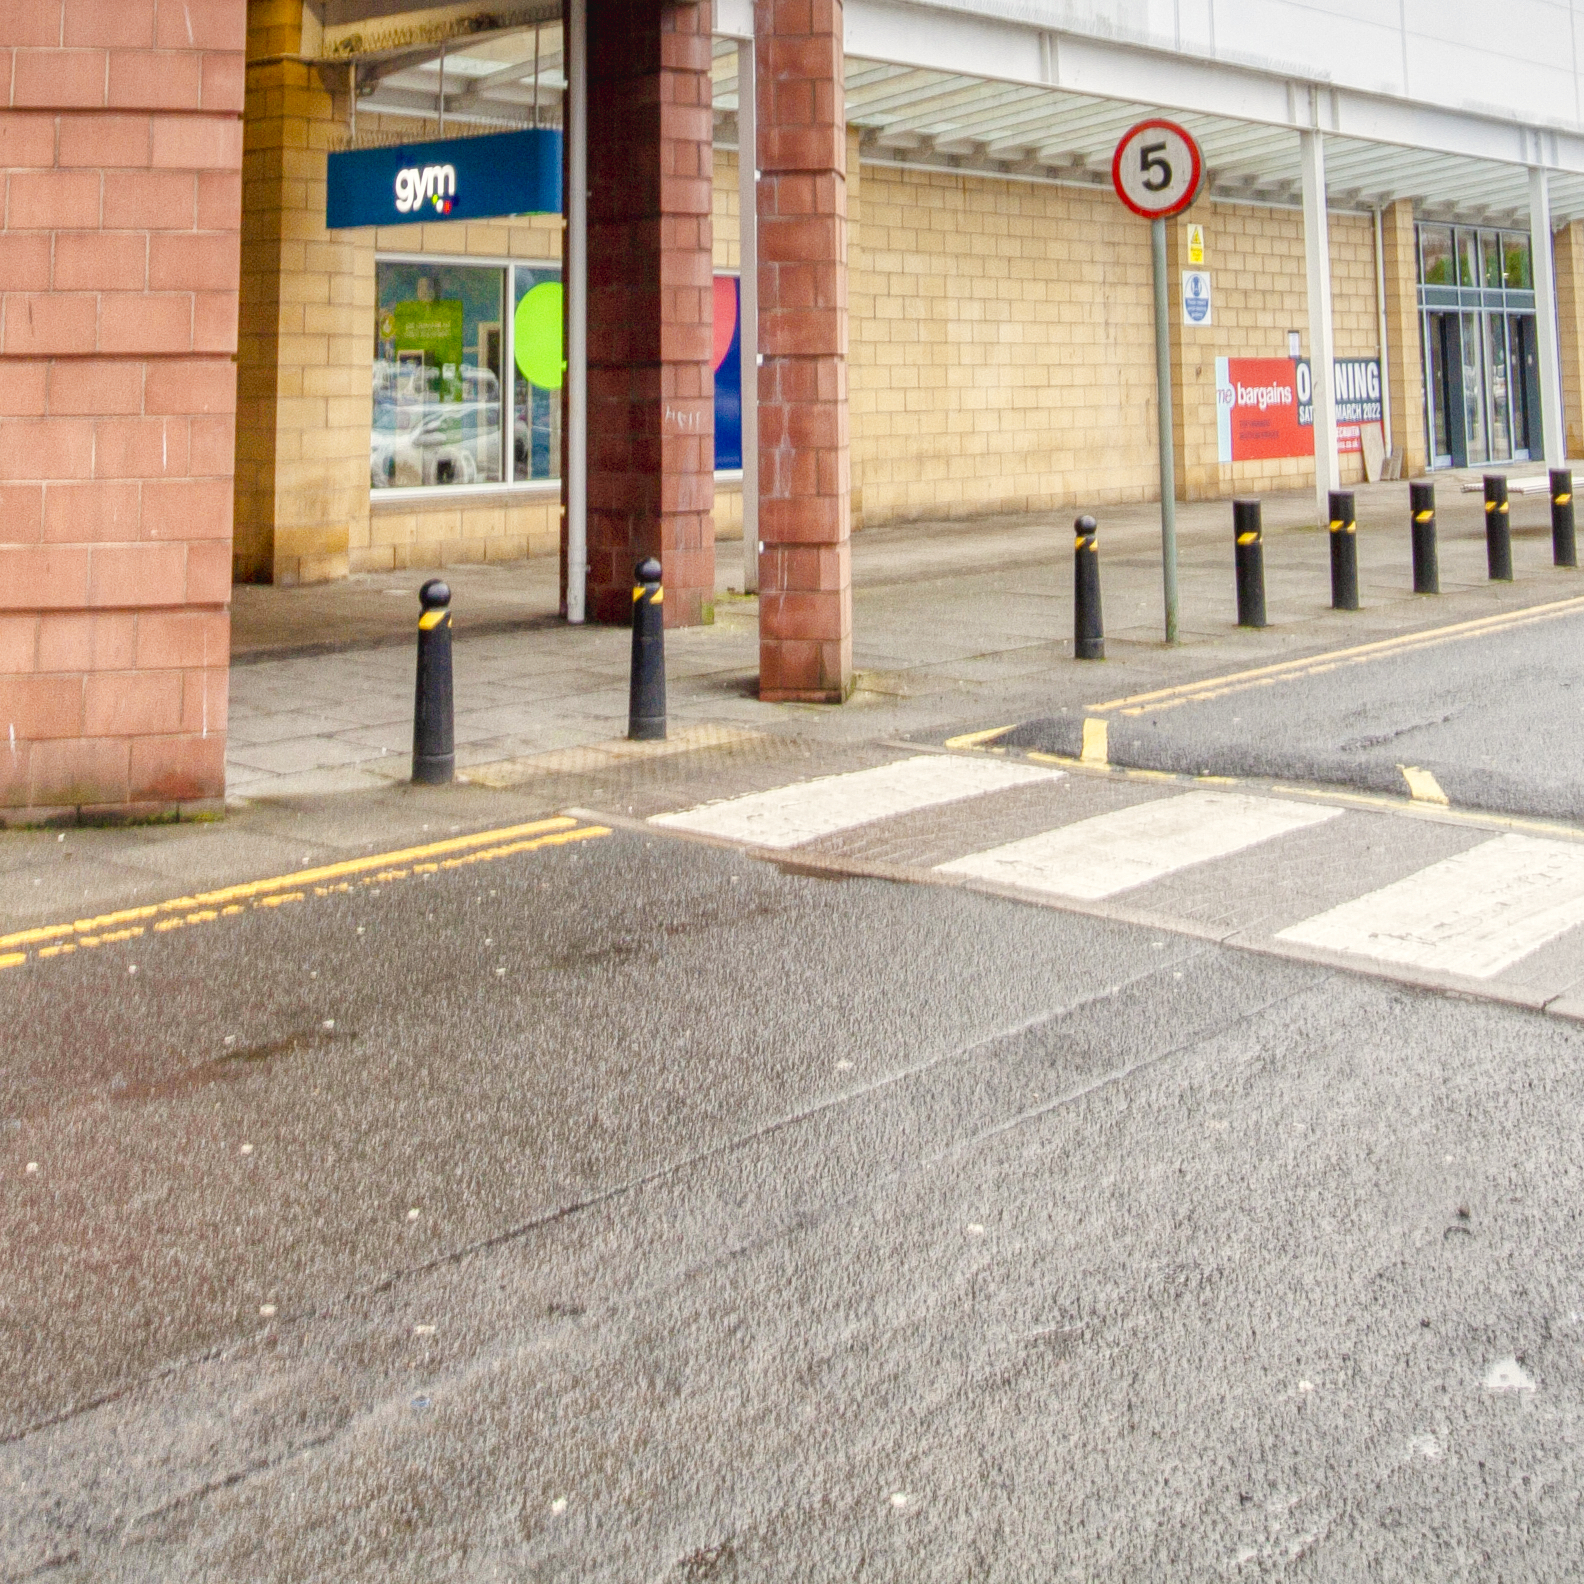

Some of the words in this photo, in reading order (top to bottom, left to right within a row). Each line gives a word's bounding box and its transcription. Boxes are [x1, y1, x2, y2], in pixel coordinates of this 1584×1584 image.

[1139, 140, 1172, 192] 5
[395, 164, 456, 213] gym
[1237, 381, 1293, 412] bargains
[1296, 361, 1381, 403] ONING
[1336, 402, 1362, 422] MARCH
[1362, 401, 1381, 421] 2022
